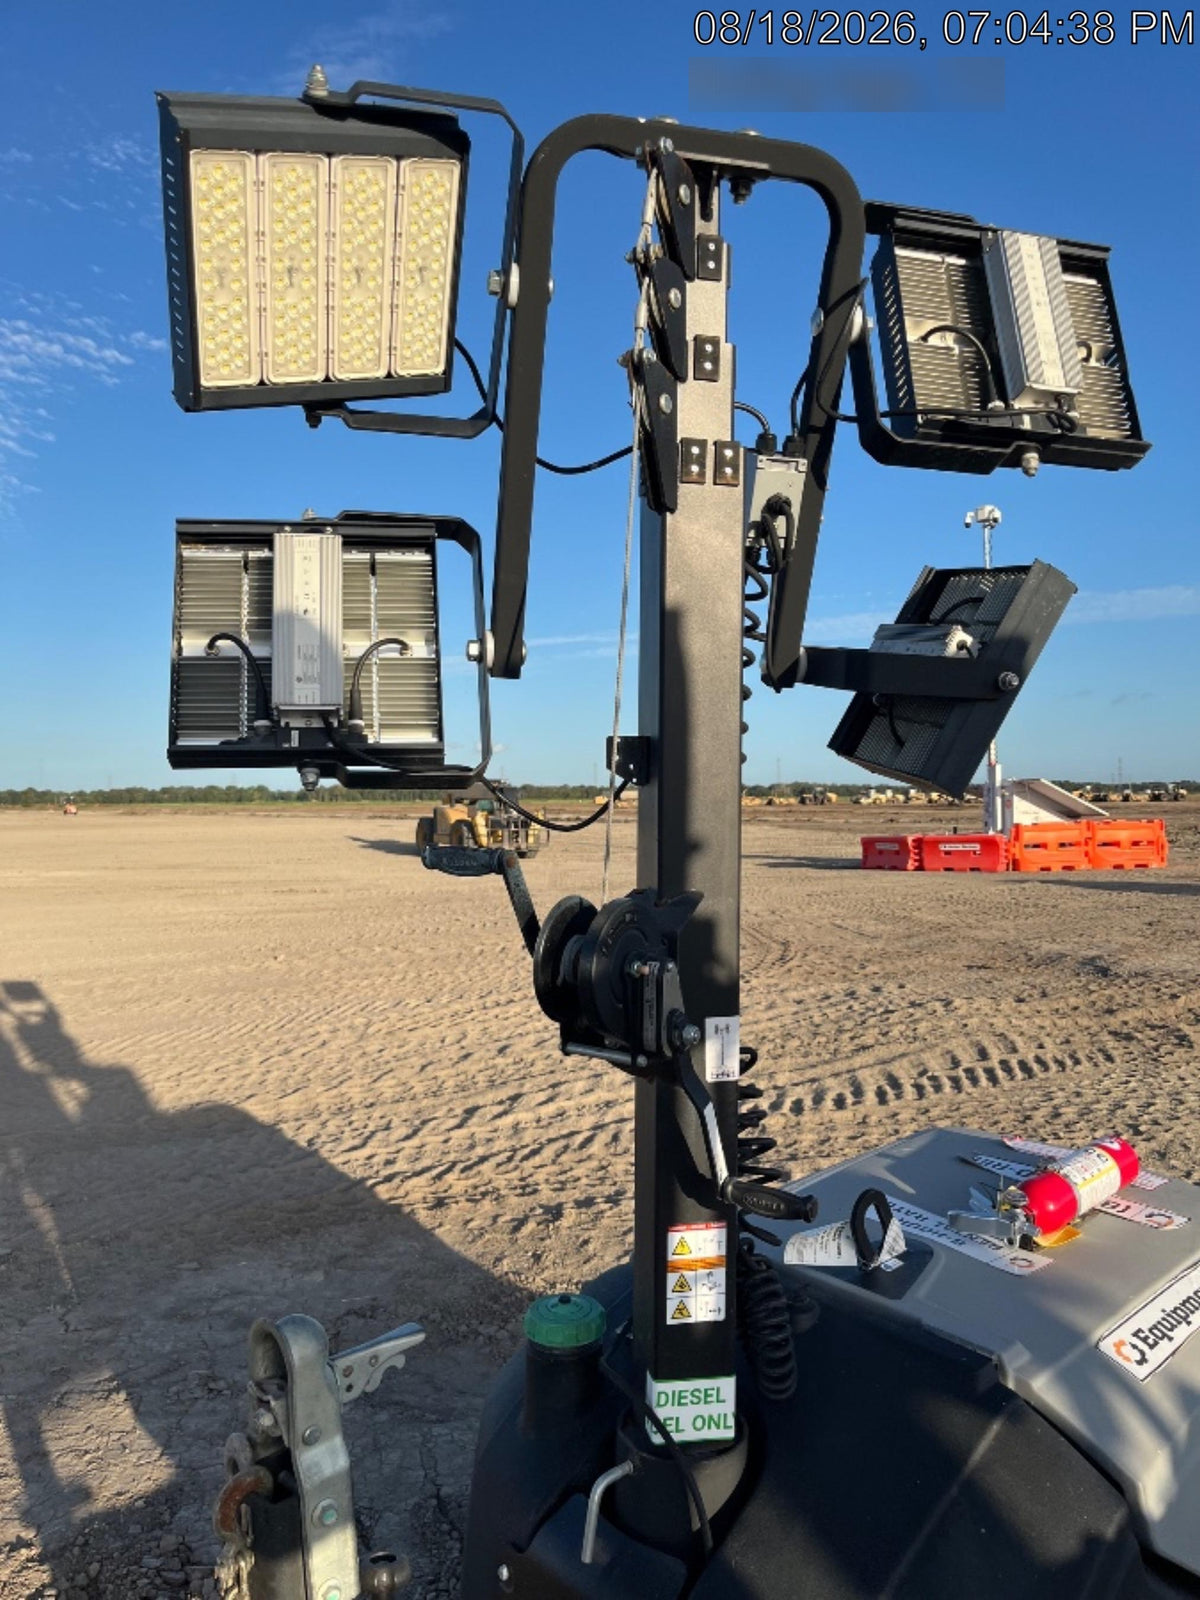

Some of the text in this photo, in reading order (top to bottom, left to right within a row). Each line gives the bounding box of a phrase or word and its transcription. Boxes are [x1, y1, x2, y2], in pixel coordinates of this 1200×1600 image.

[655, 1386, 726, 1409] DIESEL
[646, 1411, 736, 1436] EL ONL
